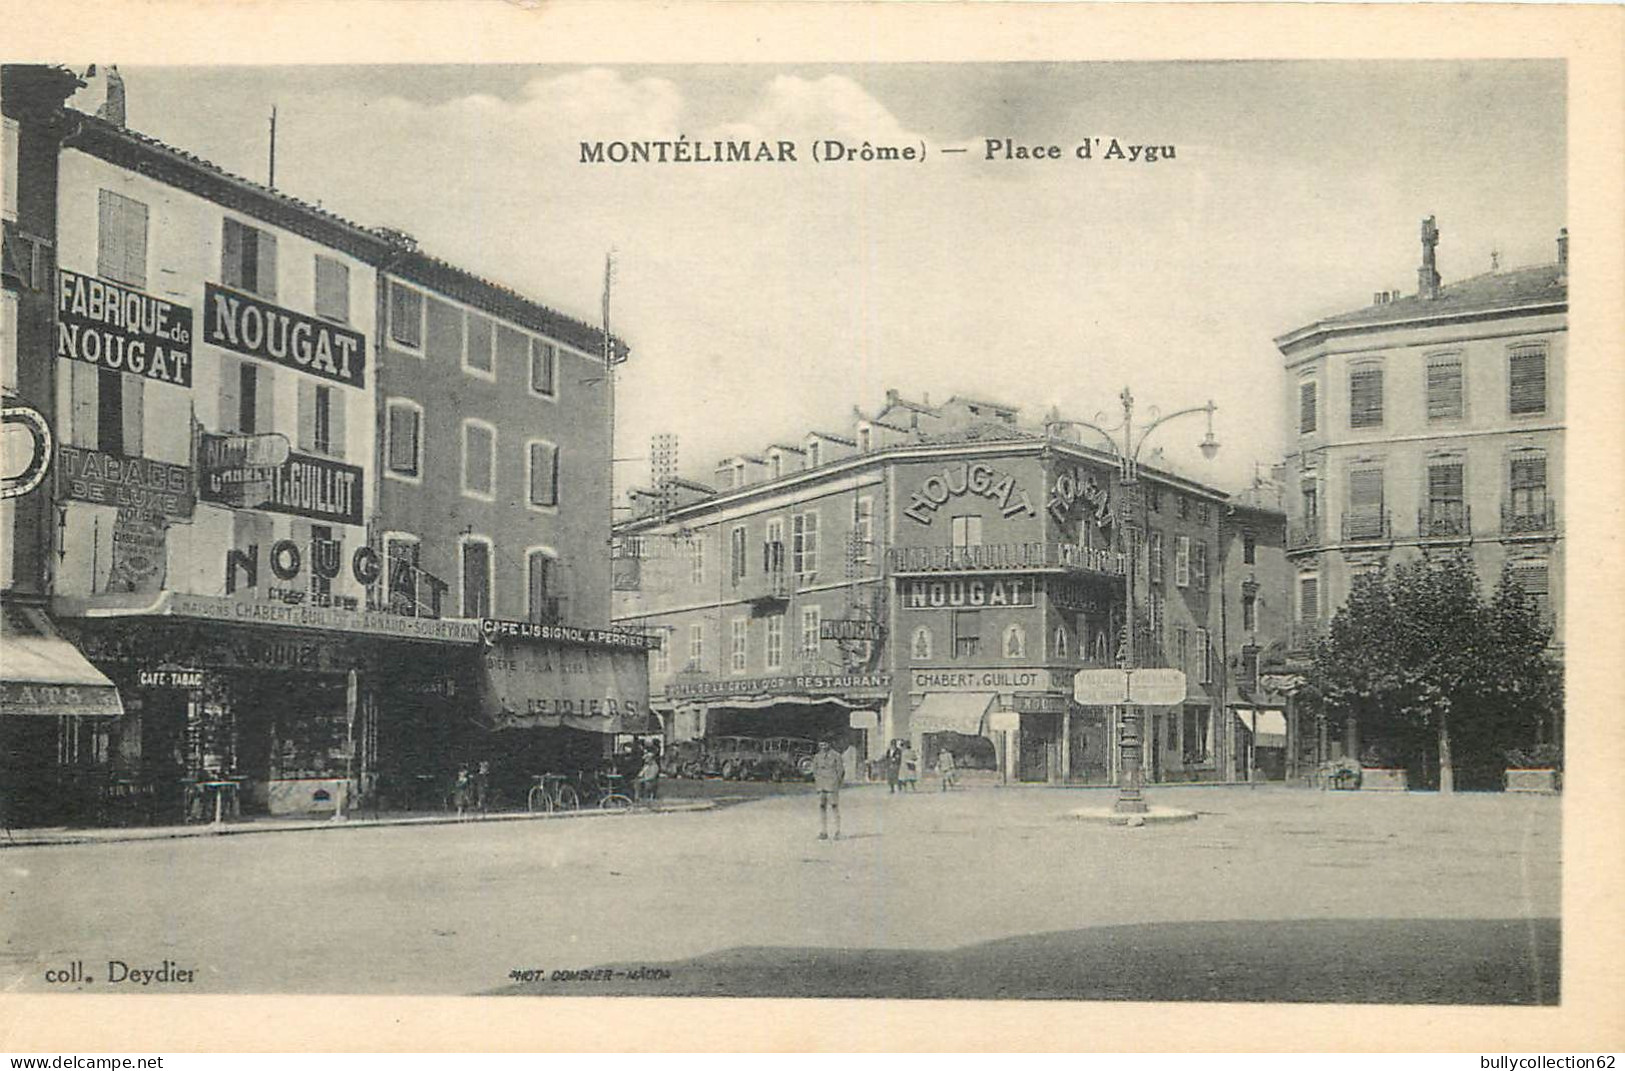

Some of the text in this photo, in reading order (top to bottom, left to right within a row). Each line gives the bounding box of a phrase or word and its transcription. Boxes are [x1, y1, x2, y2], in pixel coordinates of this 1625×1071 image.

[60, 272, 190, 344] FABRIQUE de
[58, 321, 189, 384] NOUGAT
[213, 293, 357, 378] NOUGAT
[70, 479, 179, 515] DE LUXE
[291, 461, 356, 515] GUILLOT
[903, 461, 1036, 526] NOUGAT
[235, 602, 292, 622] CHABERT
[911, 578, 1024, 608] NOUGAT
[796, 675, 891, 688] RESTAURANT
[915, 674, 974, 687] CHABERT
[982, 673, 1038, 687] GUILLOT
